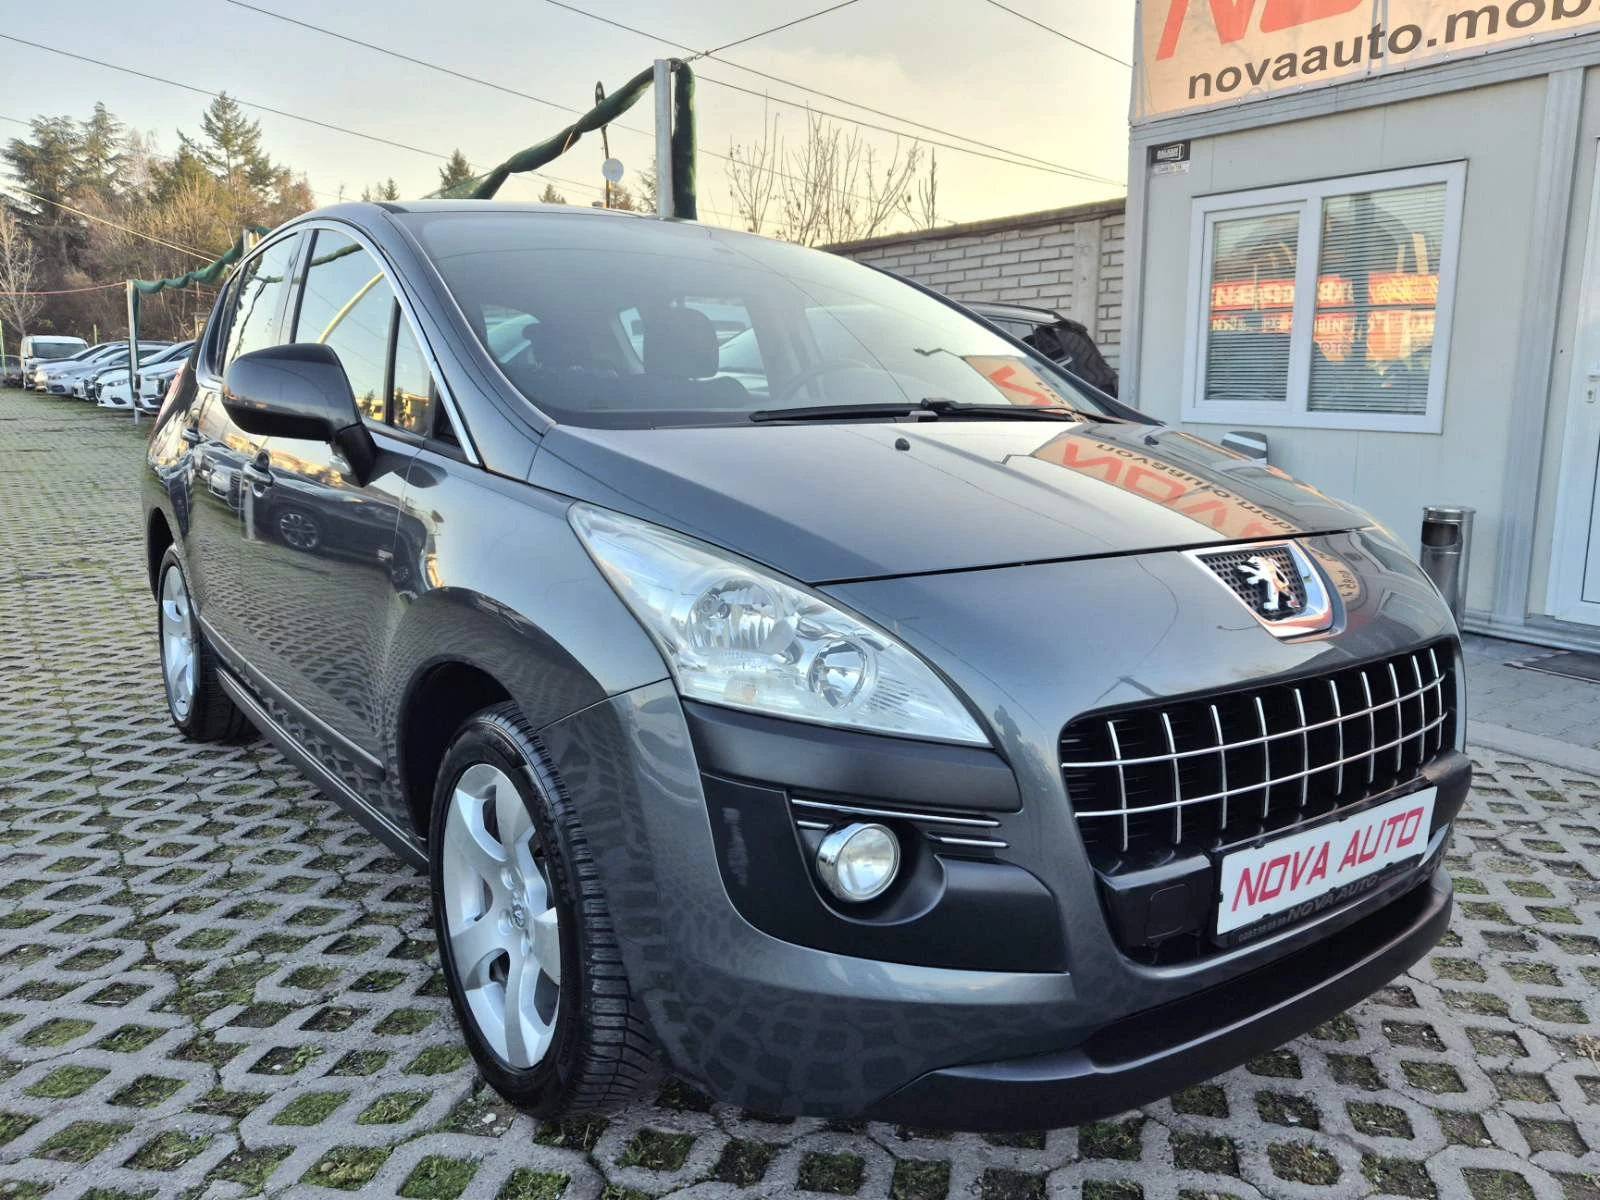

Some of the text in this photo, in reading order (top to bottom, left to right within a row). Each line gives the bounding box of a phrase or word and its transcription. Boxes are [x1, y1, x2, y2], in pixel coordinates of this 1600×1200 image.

[1188, 0, 1600, 100] novaauto.mob
[1231, 806, 1424, 912] NOVA AUTO
[1287, 875, 1377, 921] NOVA AUTO
